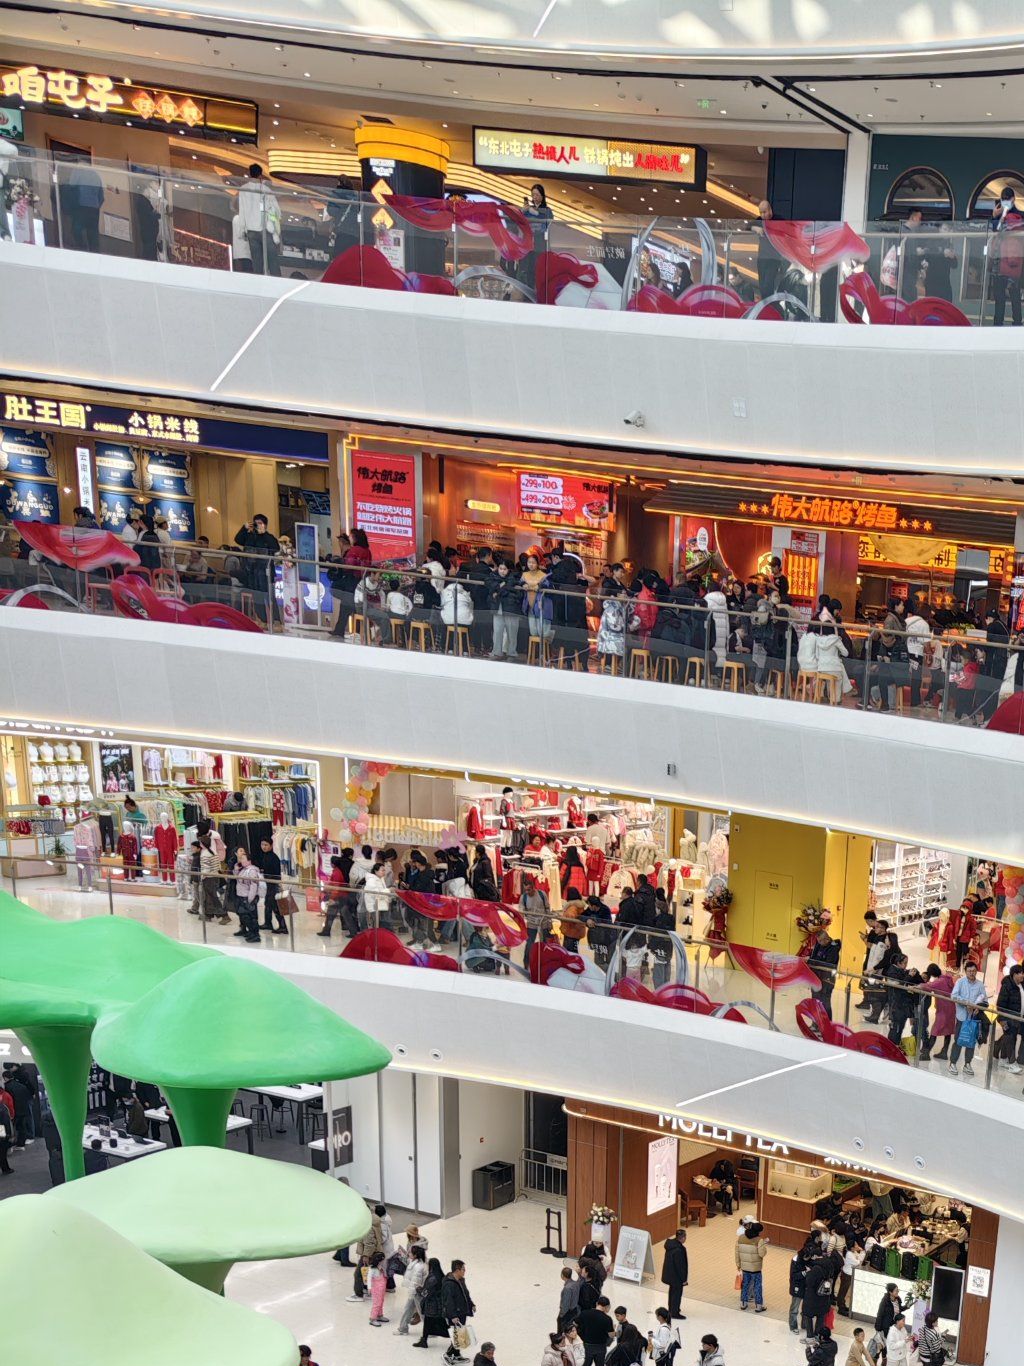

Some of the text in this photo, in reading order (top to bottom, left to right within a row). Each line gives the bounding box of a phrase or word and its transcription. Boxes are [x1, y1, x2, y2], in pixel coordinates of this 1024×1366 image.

[2, 66, 123, 112] 咱屯子
[5, 395, 87, 429] 肚王国
[128, 411, 200, 434] 小锅米线
[357, 466, 407, 484] 伟大航路
